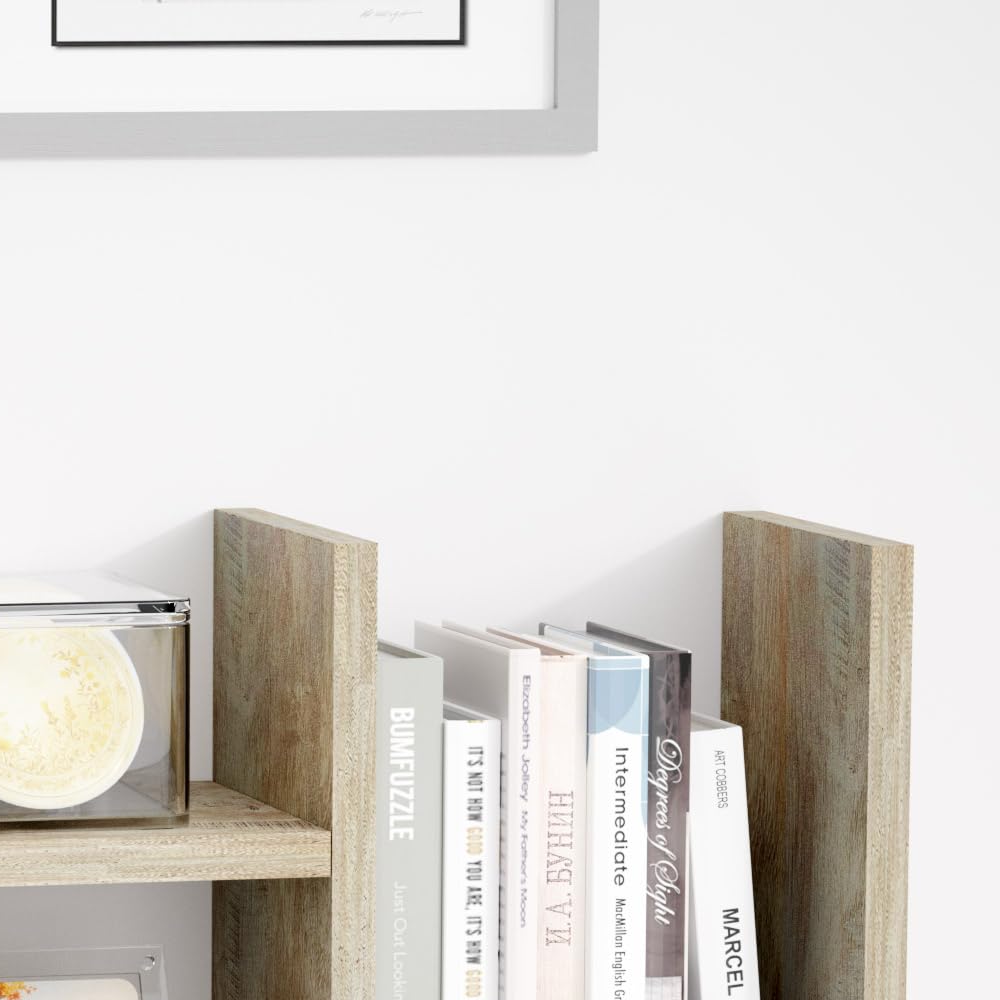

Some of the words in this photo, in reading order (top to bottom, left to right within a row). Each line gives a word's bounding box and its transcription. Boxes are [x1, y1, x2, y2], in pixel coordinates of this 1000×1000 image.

[521, 675, 532, 750] Elizabeth
[467, 746, 484, 767] IT'S
[714, 750, 726, 767] ART
[389, 706, 415, 841] BUMFUZZLE
[467, 771, 484, 793] NOT
[519, 754, 531, 802] Jolley
[648, 736, 683, 829] Degrees
[714, 768, 730, 809] COBBERS
[466, 798, 484, 822] HOW
[614, 746, 630, 886] Intermediate
[466, 826, 483, 856] GOOD
[648, 834, 676, 862] of
[466, 860, 482, 881] YOU
[393, 881, 408, 913] Just
[646, 859, 682, 926] Sight
[393, 917, 407, 947] Out
[465, 916, 482, 936] IT'S
[614, 898, 627, 948] MacMillan
[465, 940, 482, 965] HOW
[721, 907, 745, 996] MARCEL
[465, 968, 482, 998] GOOD
[612, 952, 627, 986] English
